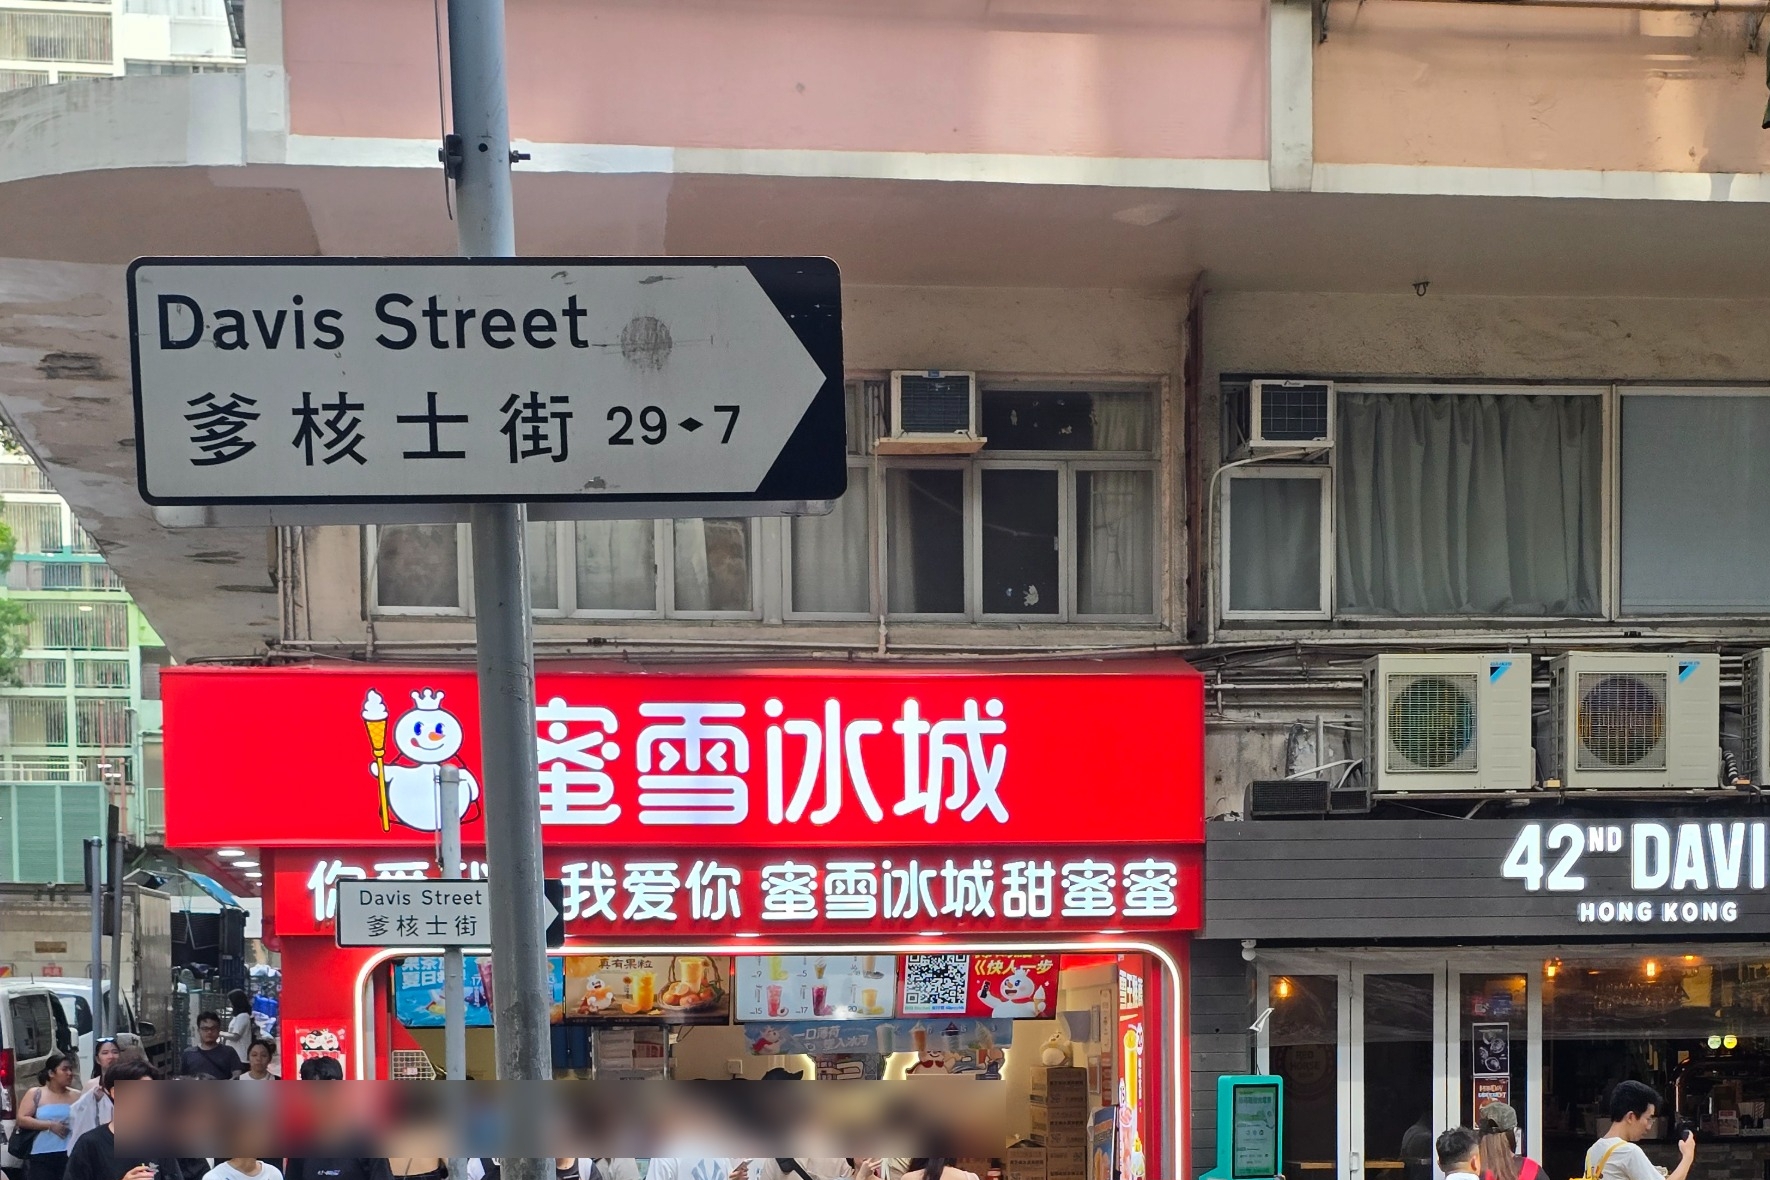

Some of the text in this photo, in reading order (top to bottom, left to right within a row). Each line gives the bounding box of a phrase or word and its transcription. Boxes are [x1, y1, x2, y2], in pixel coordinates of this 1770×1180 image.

[158, 293, 589, 351] Davis Street
[184, 391, 740, 466] 爹核士街 29 7
[536, 697, 1010, 826] 蜜雪冰城
[360, 889, 482, 905] Davis Street
[761, 858, 1177, 920] 蜜雪冰城甜蜜蜜
[1577, 901, 1738, 923] HONG KONG
[367, 914, 477, 938] 爹核士街
